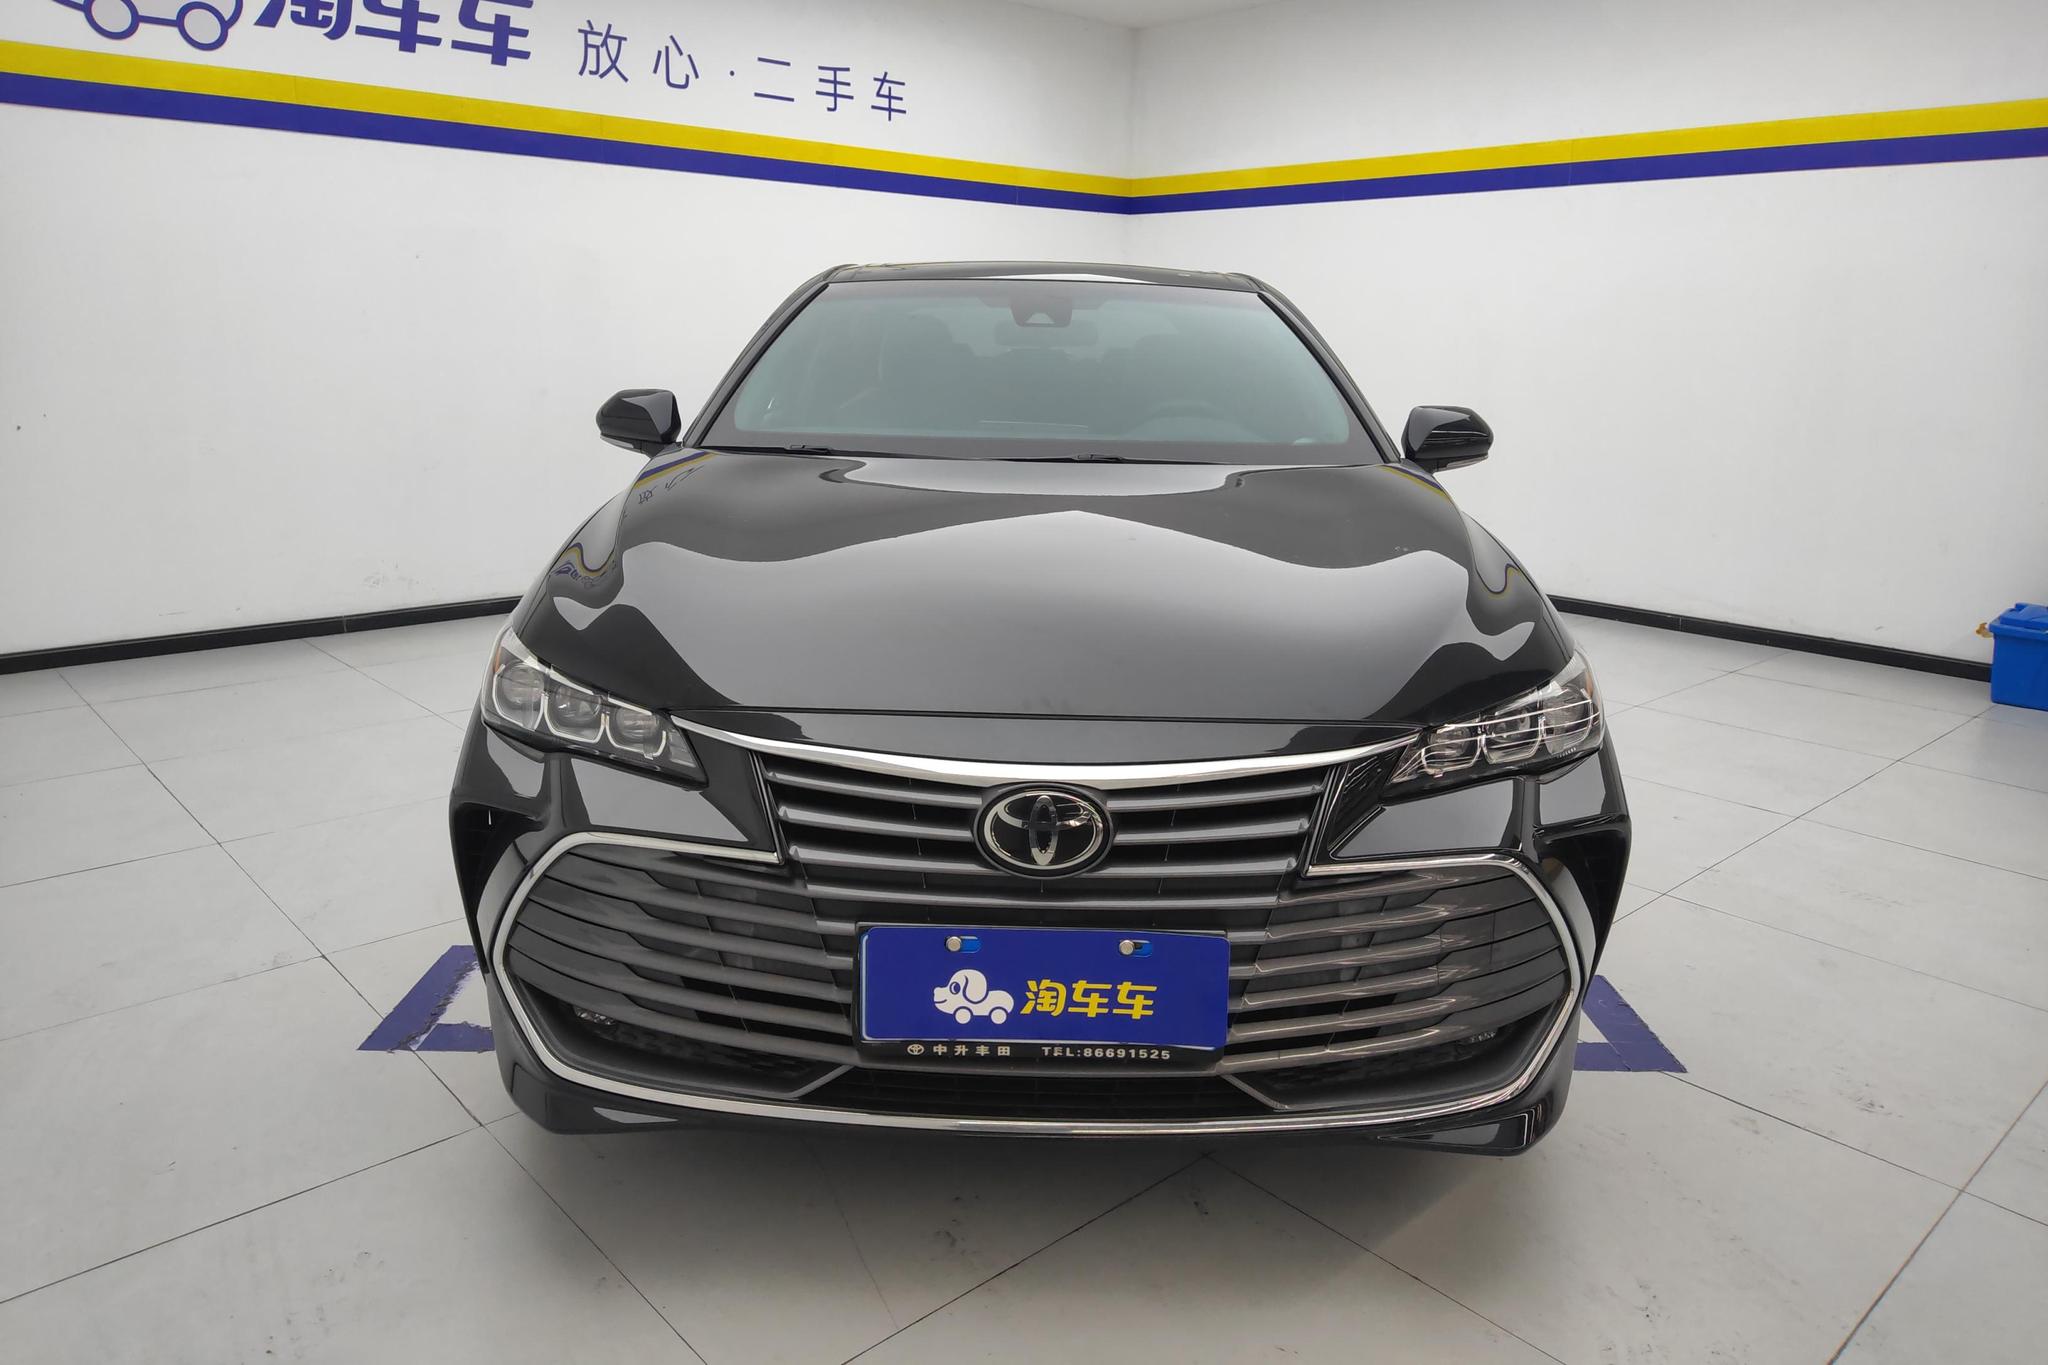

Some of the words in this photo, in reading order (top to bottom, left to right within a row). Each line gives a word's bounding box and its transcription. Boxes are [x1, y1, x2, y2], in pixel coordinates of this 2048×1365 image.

[1020, 978, 1157, 1020] 淘车车
[932, 1044, 1011, 1057] 中升丰田
[1041, 1046, 1170, 1060] TEL:86691525
